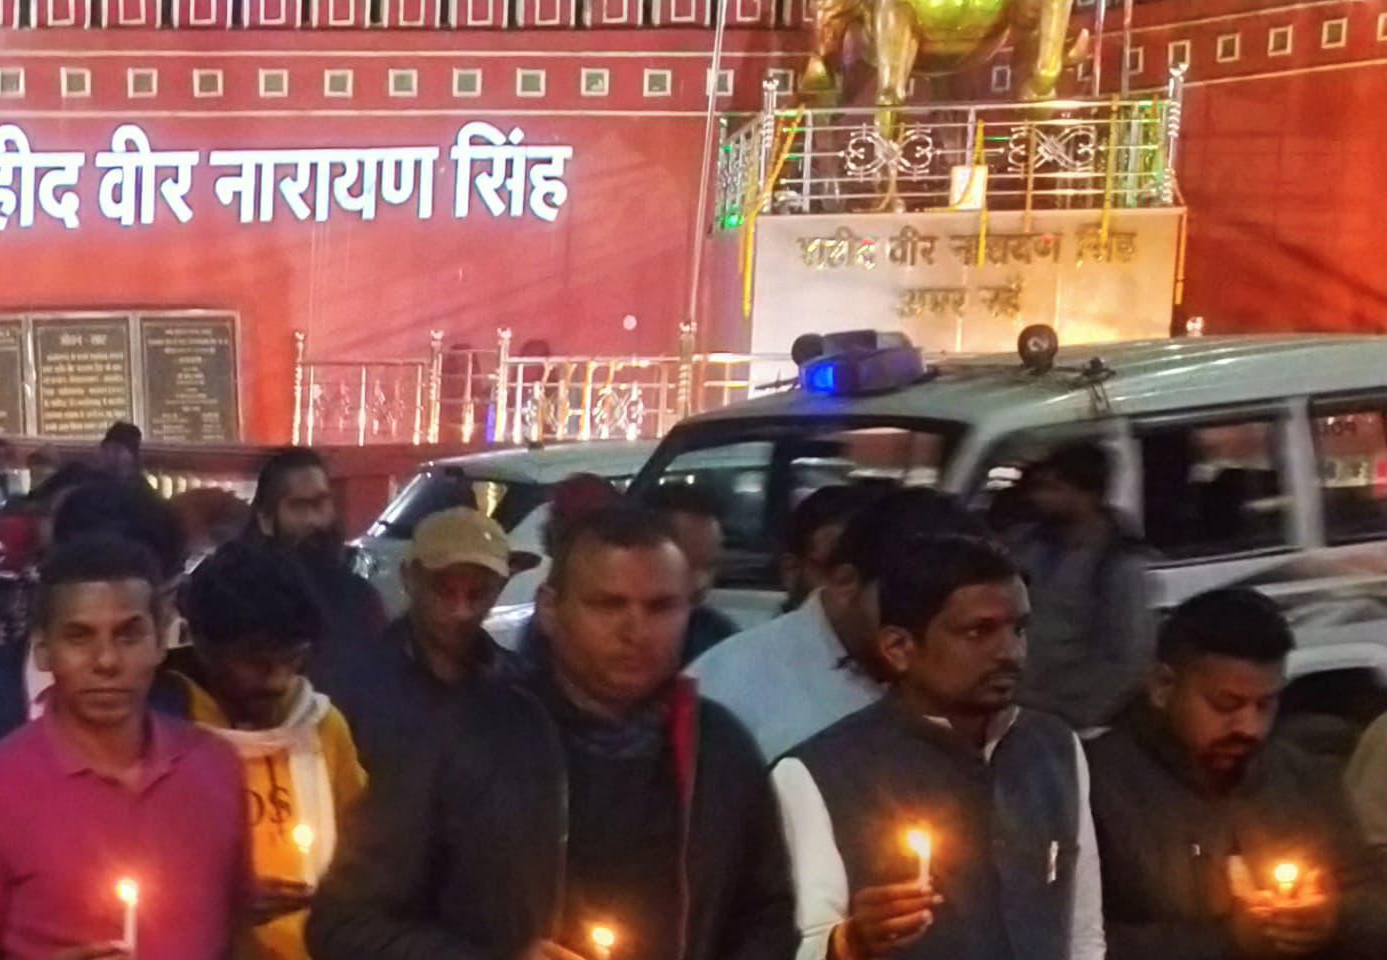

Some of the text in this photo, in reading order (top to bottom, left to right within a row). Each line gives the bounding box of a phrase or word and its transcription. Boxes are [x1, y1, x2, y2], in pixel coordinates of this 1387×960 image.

[96, 124, 199, 226] वीर
[210, 146, 439, 223] नारायण
[450, 120, 573, 222] सिंह
[888, 225, 940, 267] वीर
